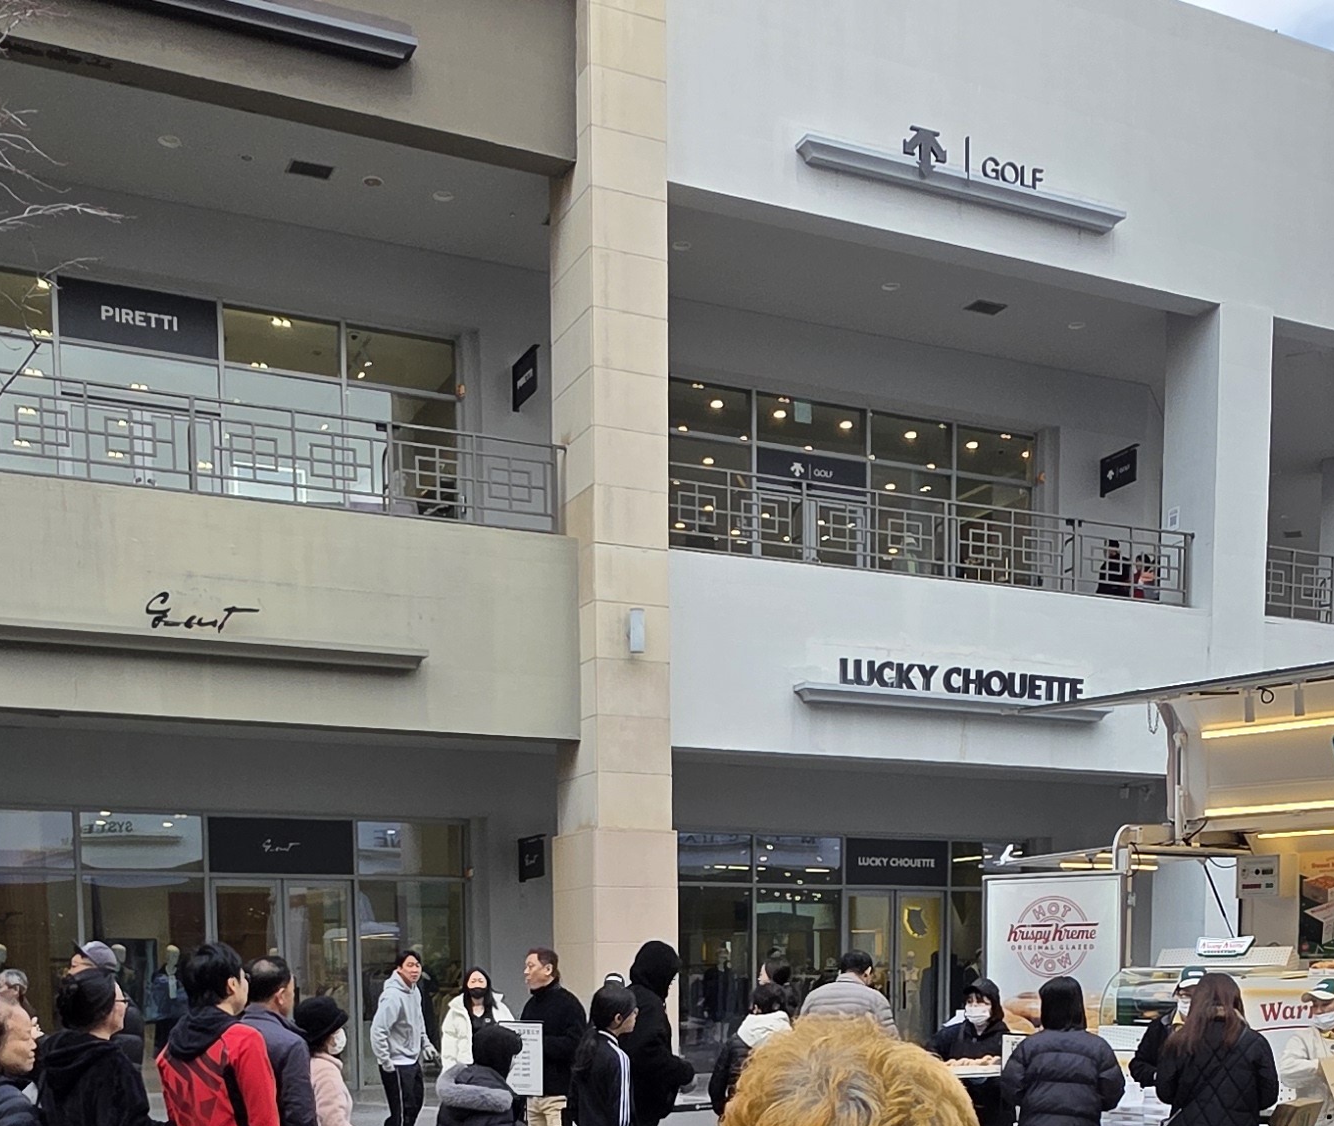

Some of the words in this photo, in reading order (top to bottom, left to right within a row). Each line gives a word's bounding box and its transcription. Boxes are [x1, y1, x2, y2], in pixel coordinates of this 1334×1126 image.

[982, 157, 1044, 189] GOLF
[101, 305, 178, 331] PIRETTI
[813, 468, 833, 478] GOLF
[839, 658, 939, 691] LUCKY
[943, 667, 1084, 702] CHOUETTE
[858, 856, 887, 867] LUCKY
[890, 857, 935, 868] CHOUETTE
[1032, 902, 1072, 920] HOT
[1007, 923, 1054, 944] Krispy
[1052, 922, 1099, 941] Kreme
[1030, 953, 1072, 969] NOW
